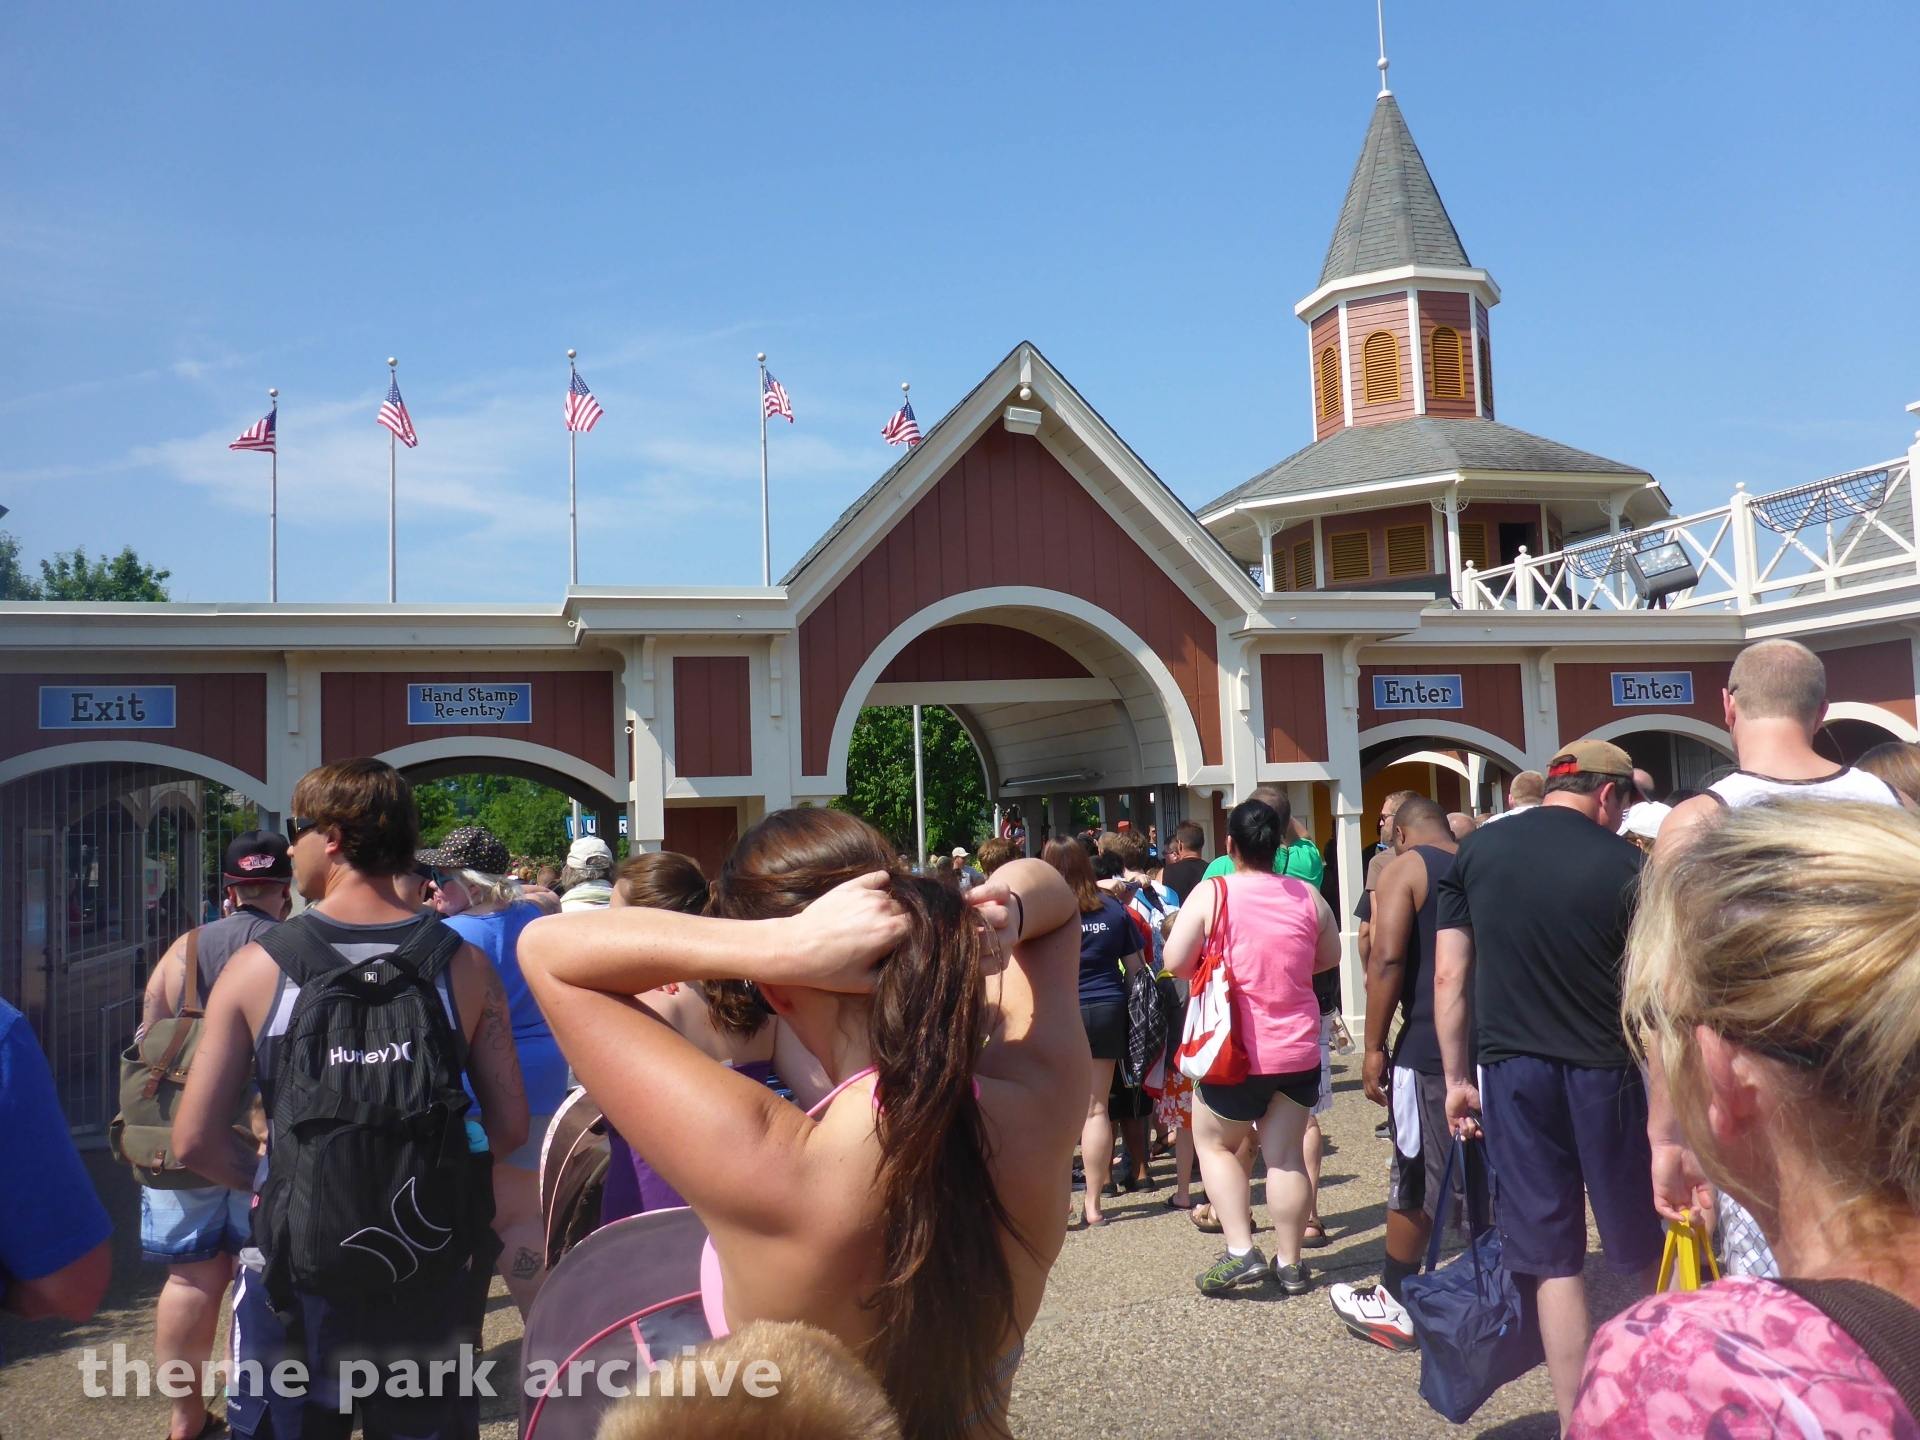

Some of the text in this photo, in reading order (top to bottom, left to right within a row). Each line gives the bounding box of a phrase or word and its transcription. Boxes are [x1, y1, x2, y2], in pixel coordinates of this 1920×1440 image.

[421, 687, 519, 706] Hand Stamp
[1384, 680, 1452, 704] Enter
[1621, 677, 1683, 700] Enter
[71, 692, 146, 722] Exit
[434, 702, 506, 721] Re-entry
[330, 1046, 390, 1066] Hurley
